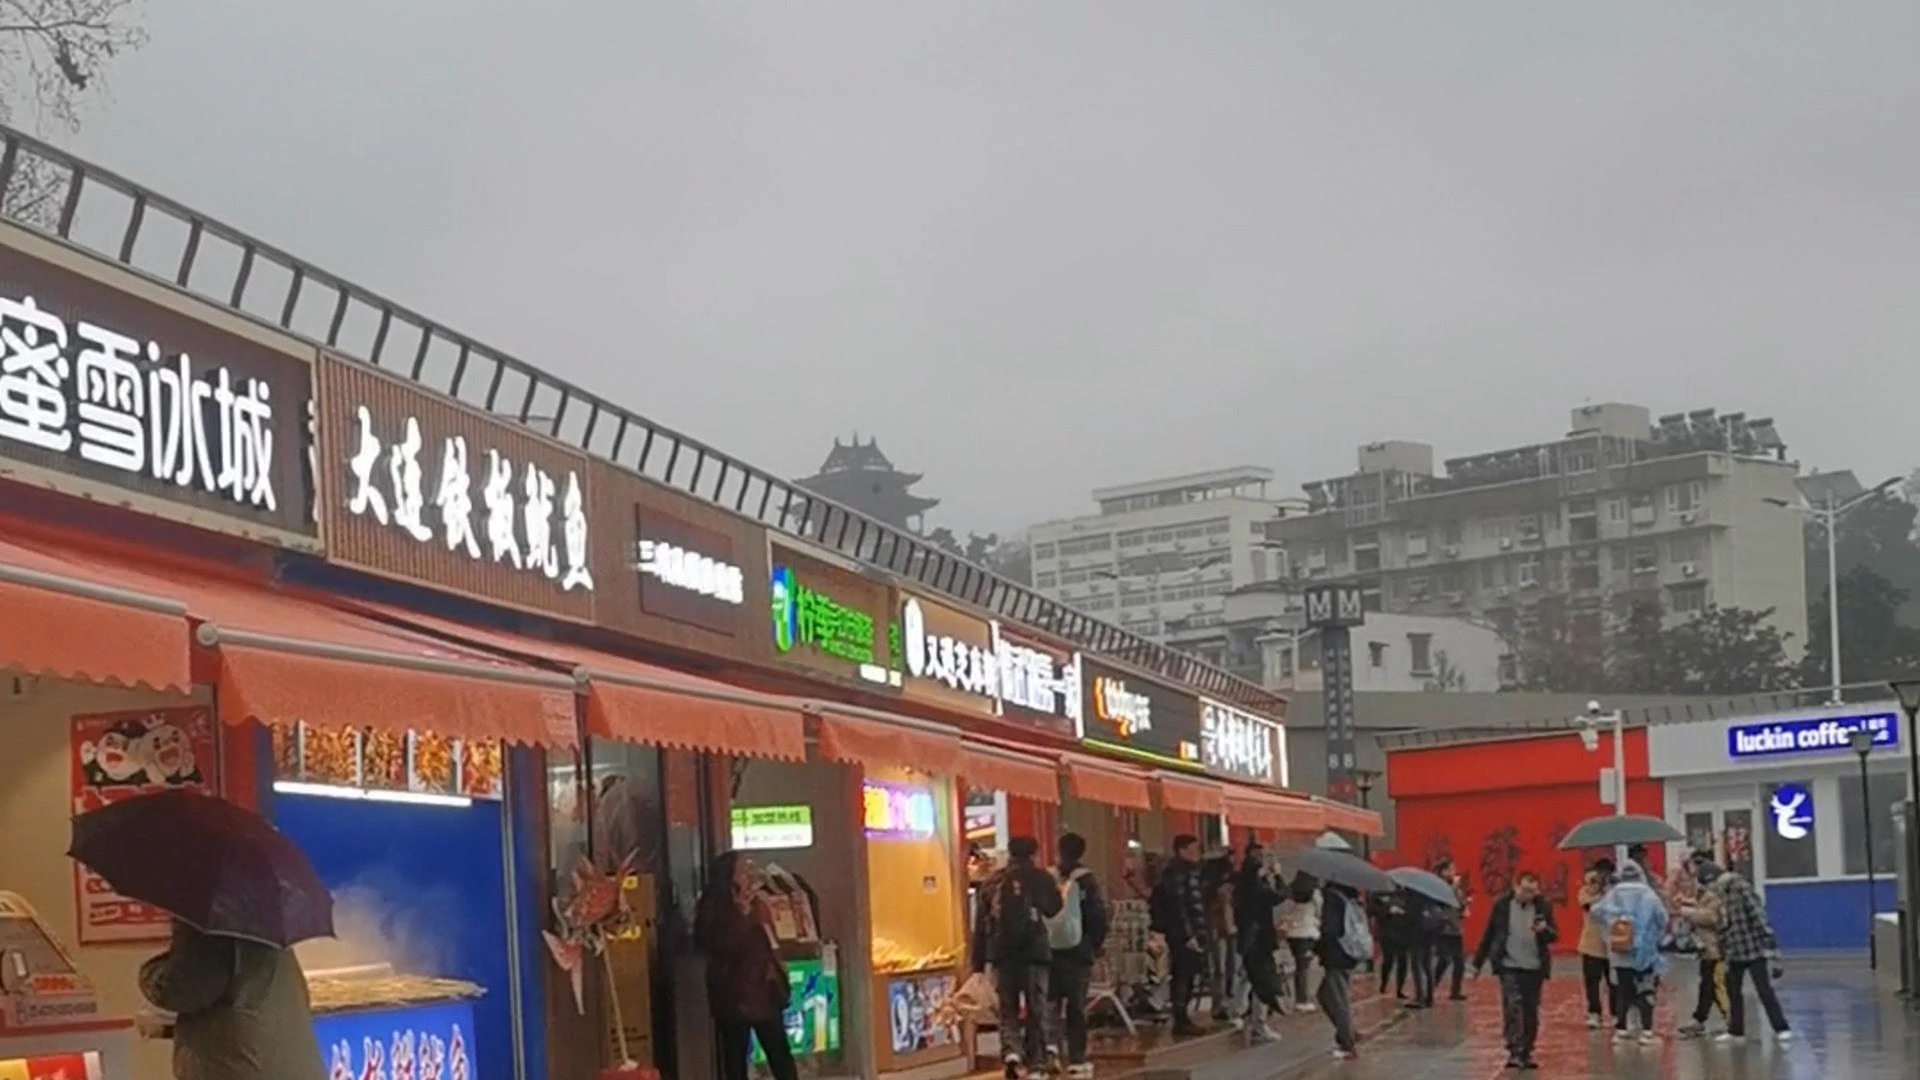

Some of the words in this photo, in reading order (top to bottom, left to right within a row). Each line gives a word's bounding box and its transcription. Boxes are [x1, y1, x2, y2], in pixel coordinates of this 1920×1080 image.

[0, 295, 276, 512] 蜜雪冰城
[350, 406, 593, 591] 大连铁板鱿鱼
[1736, 726, 1795, 752] luckin
[1798, 721, 1859, 747] coffe
